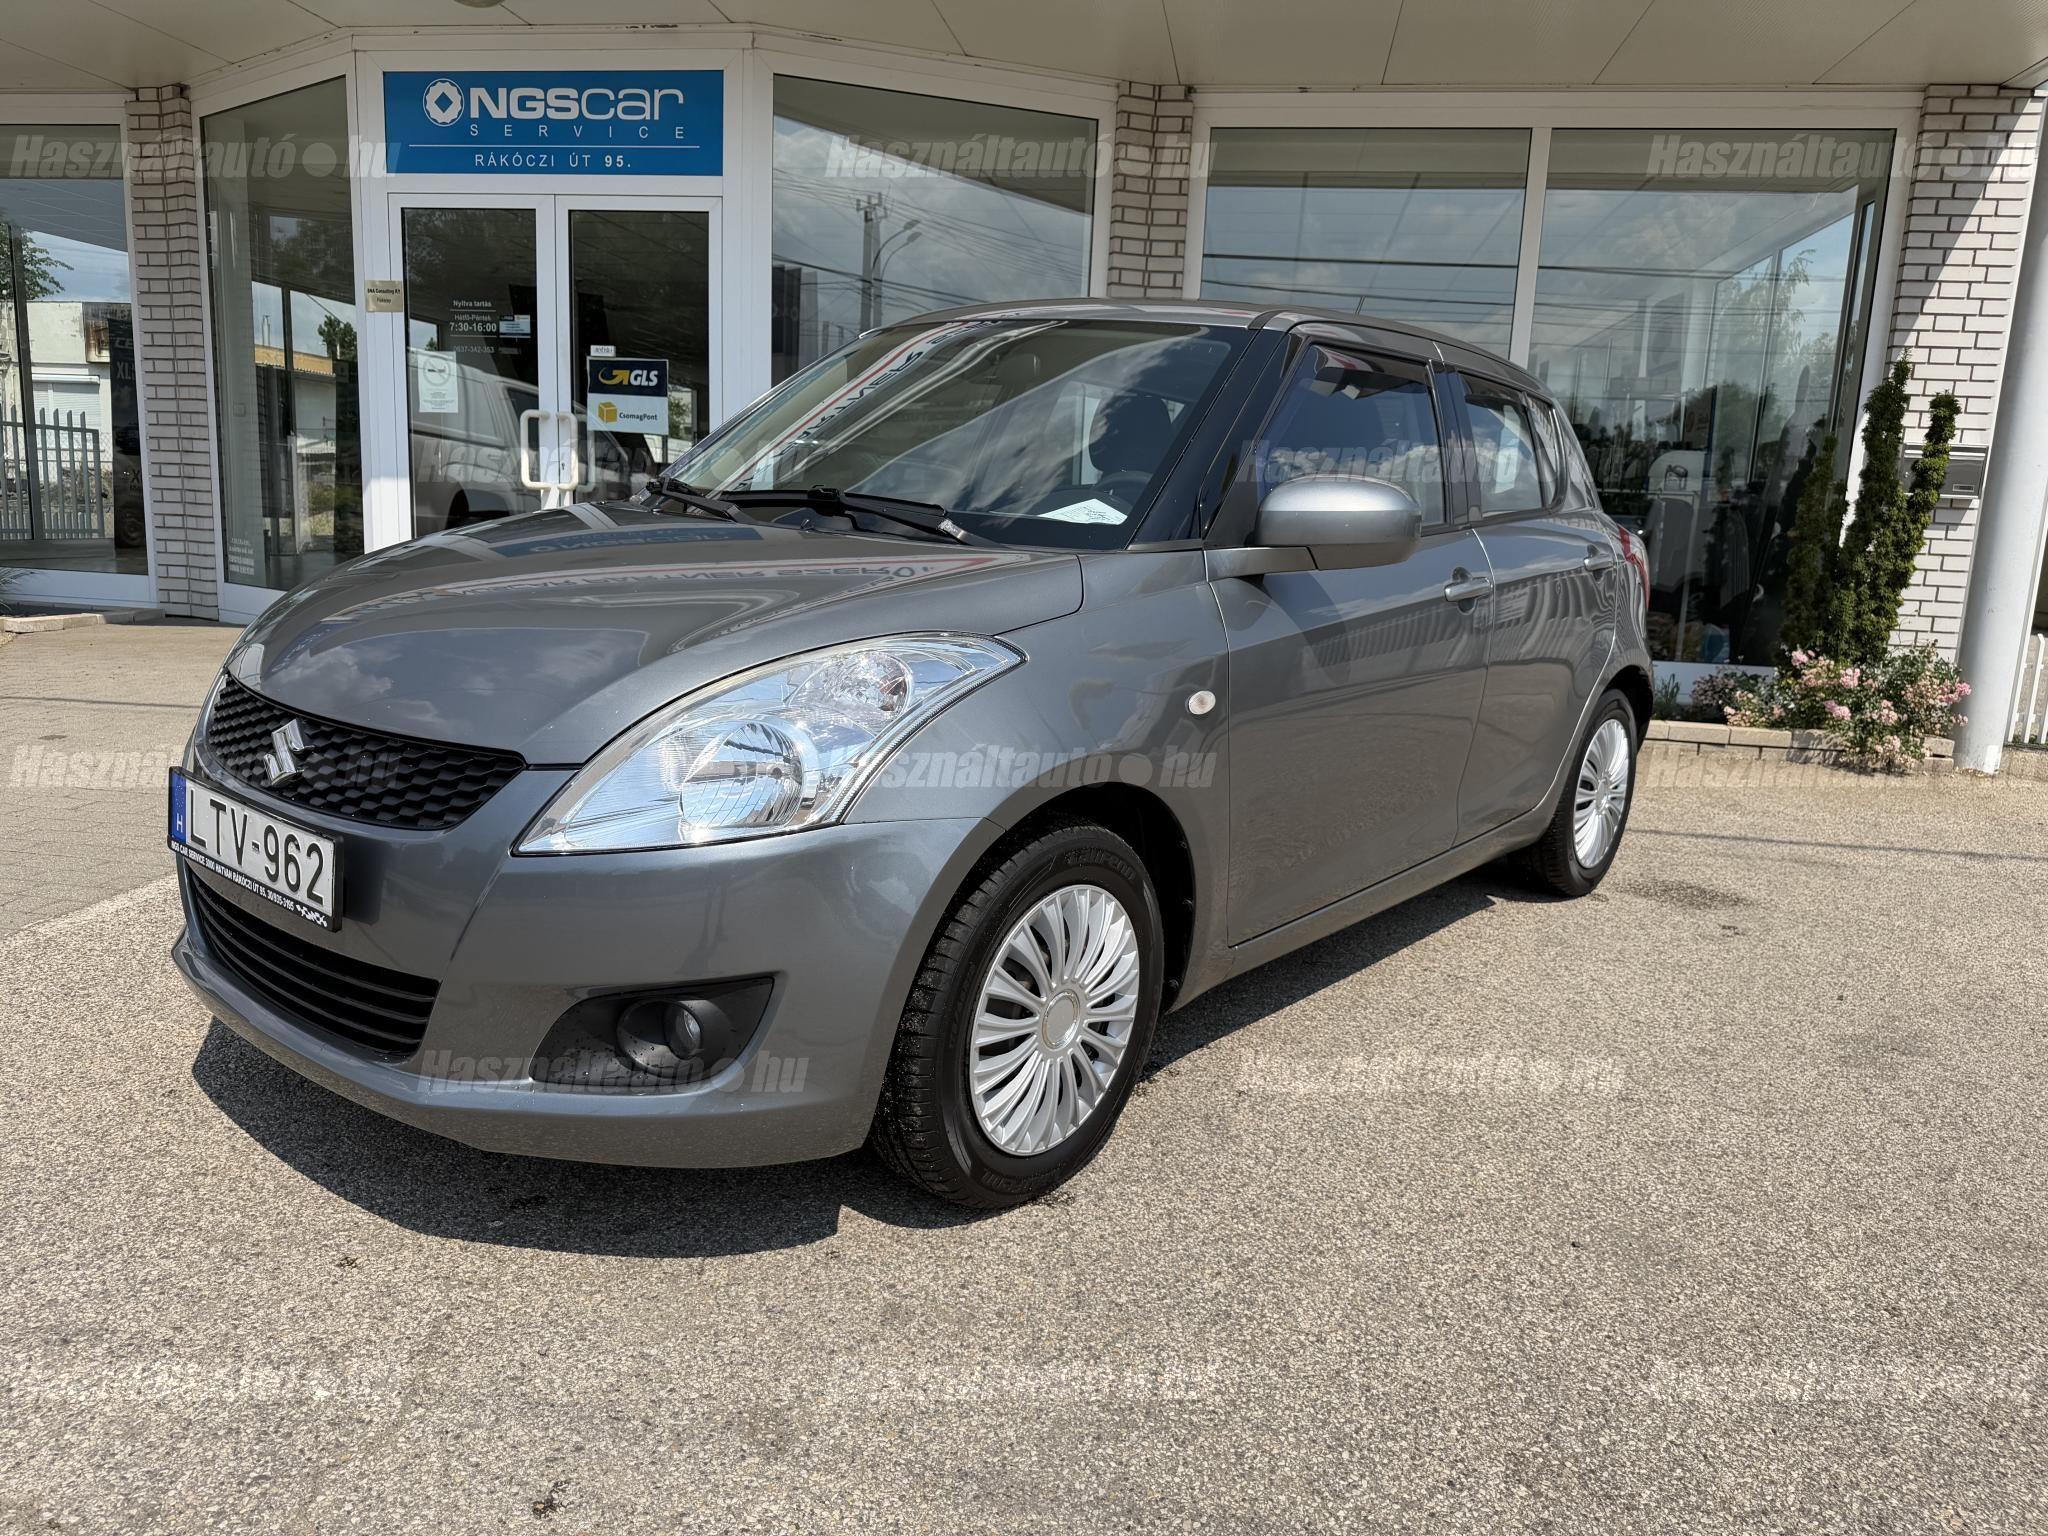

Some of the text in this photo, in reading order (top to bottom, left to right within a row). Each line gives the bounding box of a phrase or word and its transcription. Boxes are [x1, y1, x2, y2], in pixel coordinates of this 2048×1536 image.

[469, 124, 685, 139] SERVICE
[474, 151, 632, 168] RÁKÓCZI ÚT 95.
[449, 322, 497, 333] 7:30-16:00
[629, 369, 659, 387] GLS
[618, 411, 658, 422] CsomagPont
[190, 789, 325, 906] LTV-962
[180, 844, 189, 857] CAR
[188, 848, 206, 866] SERVICE
[215, 863, 233, 881] HATVAN
[232, 871, 253, 890] RÁKÓCZI
[252, 879, 260, 894] ÚT
